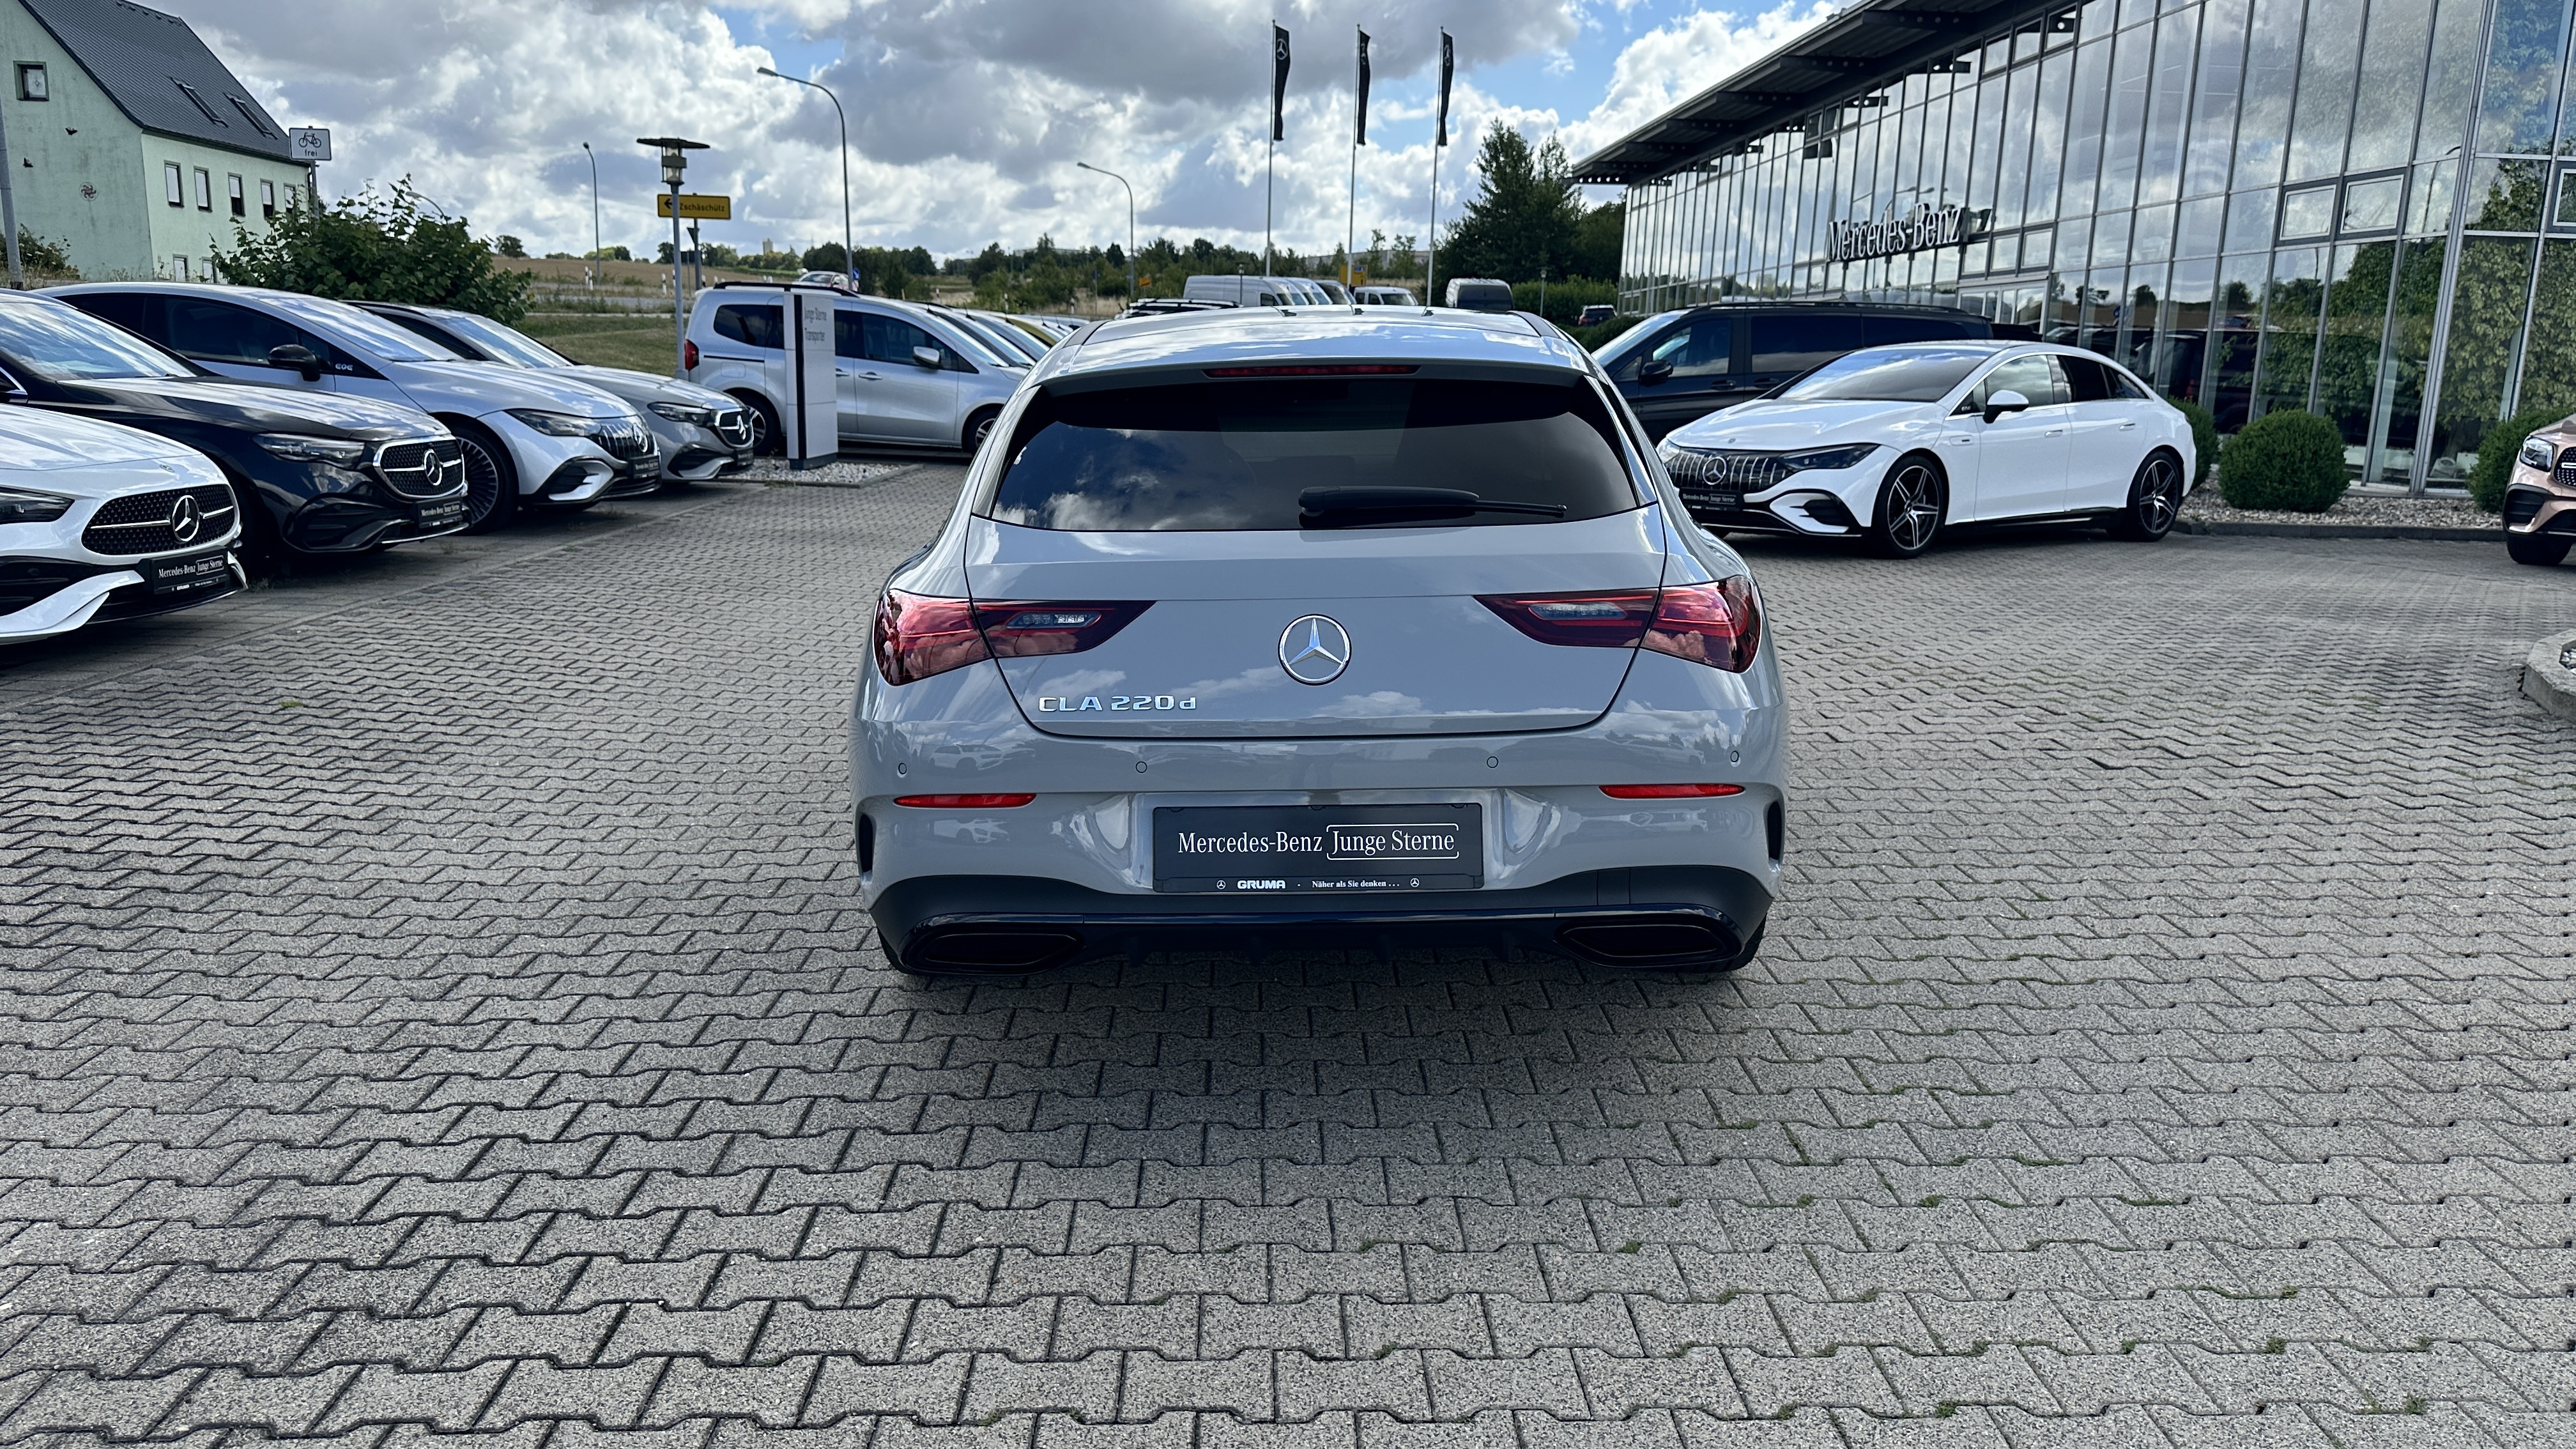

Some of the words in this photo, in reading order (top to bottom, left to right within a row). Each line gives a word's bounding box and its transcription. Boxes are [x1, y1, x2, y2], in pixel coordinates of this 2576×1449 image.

[679, 203, 725, 212] Zschäschütz
[1828, 203, 1961, 262] Mercedes-Benz
[158, 565, 196, 578] Mercedes-Benz
[197, 562, 210, 573] Junge
[210, 560, 223, 569] Sterne
[1039, 696, 1103, 712] CLA
[1177, 831, 1322, 854] Mercedes-Benz
[1332, 830, 1386, 856] Junge
[1392, 829, 1455, 851] Sterne
[1237, 880, 1286, 889] GRUMA
